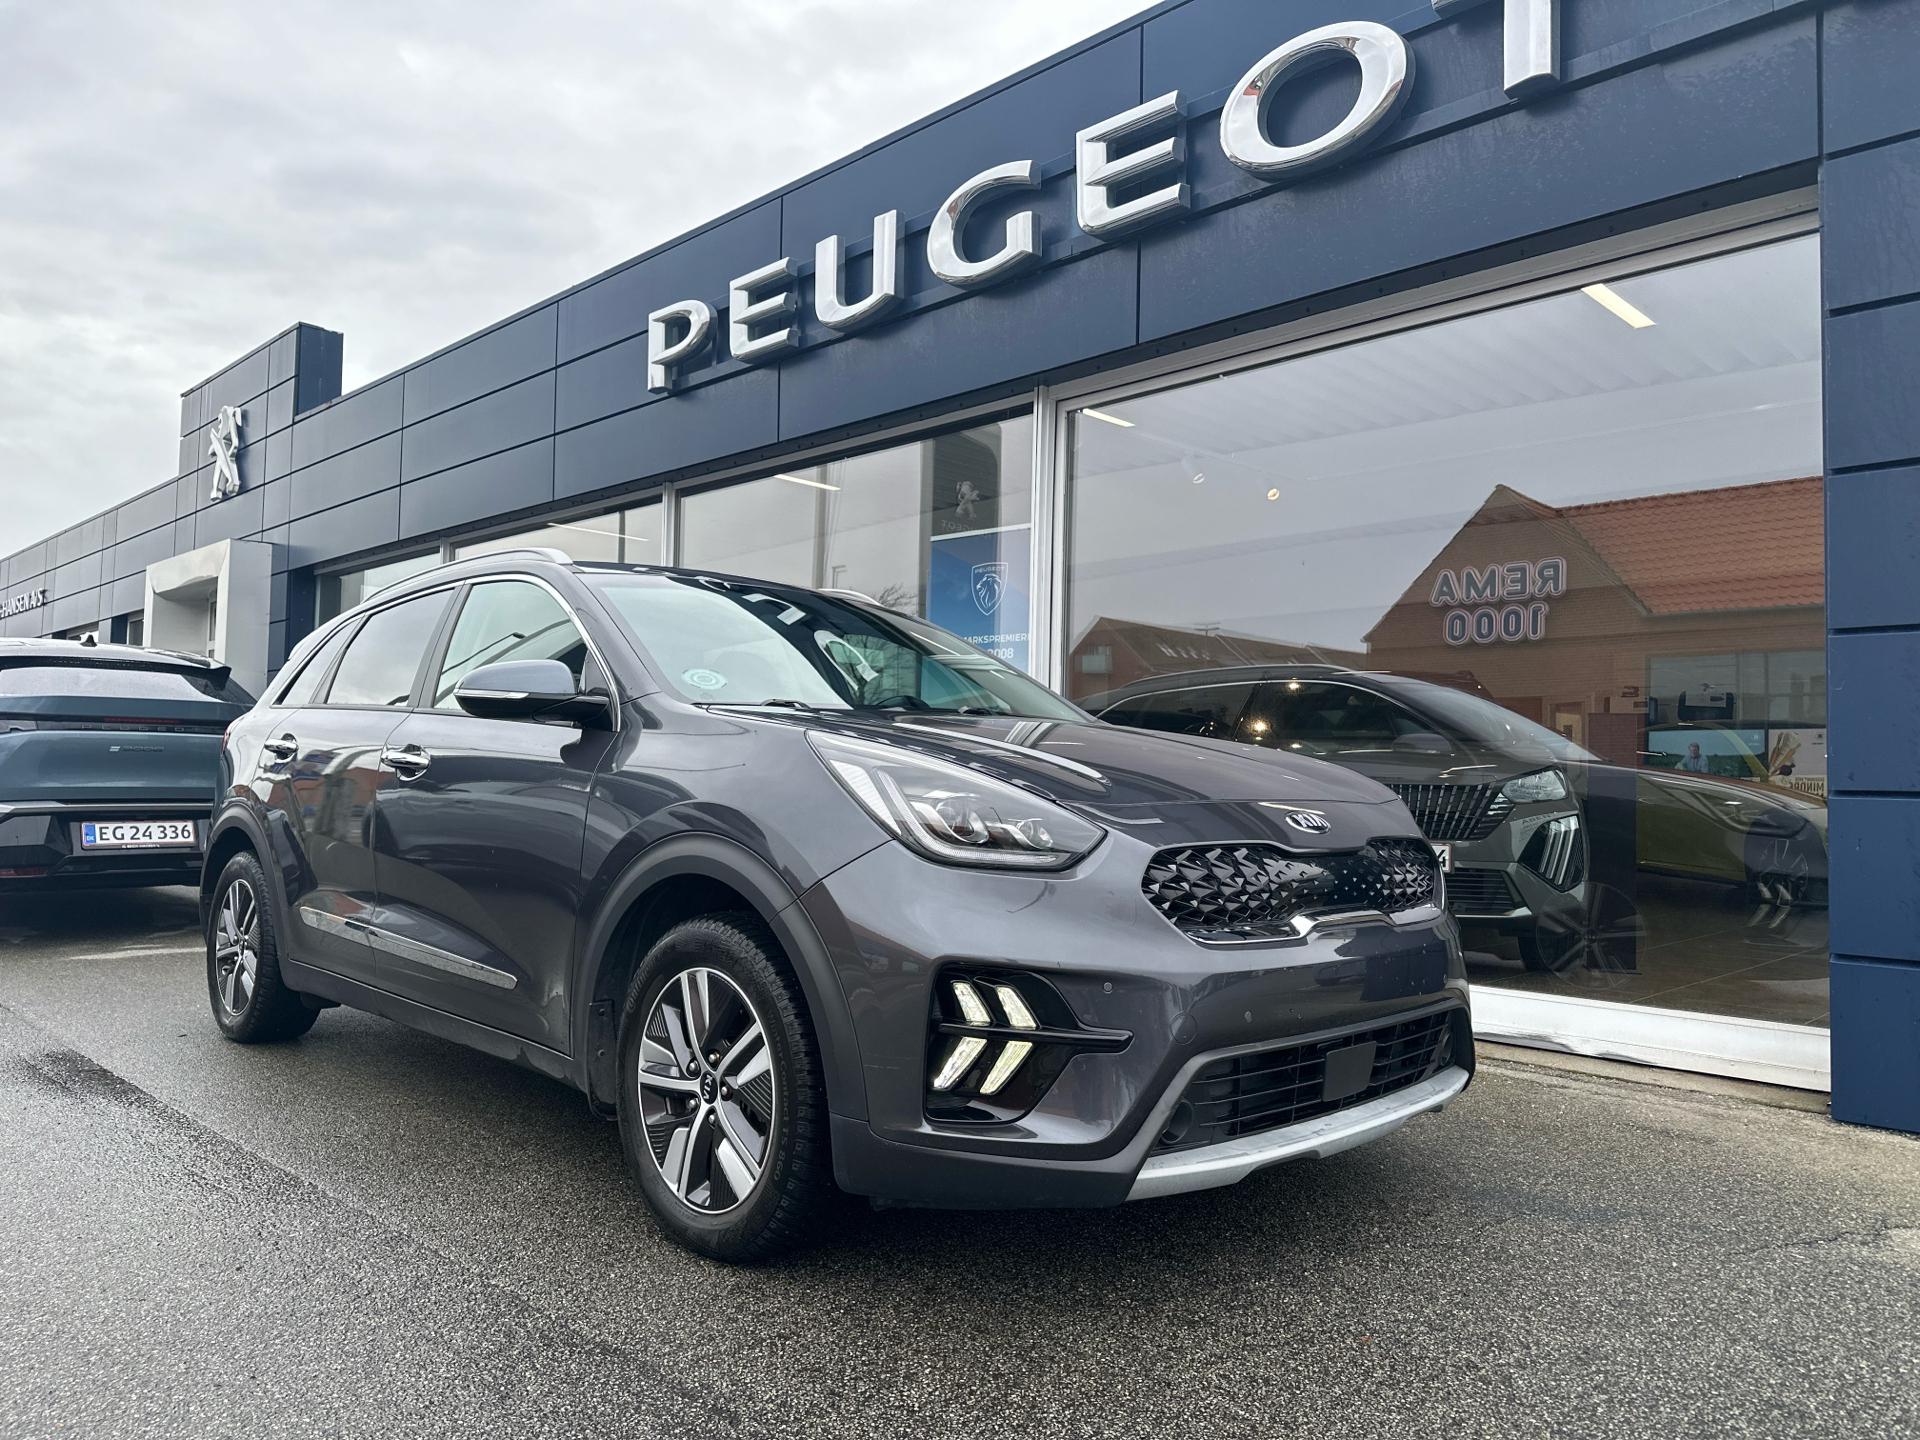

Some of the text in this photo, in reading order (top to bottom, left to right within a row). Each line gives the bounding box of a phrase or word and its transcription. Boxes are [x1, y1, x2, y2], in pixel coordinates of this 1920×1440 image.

[974, 566, 1005, 574] PEUGEOT
[964, 633, 1029, 644] ARKSPREMIER
[99, 824, 191, 841] EG 24 336
[781, 1123, 789, 1146] TS
[773, 1150, 786, 1182] 860
